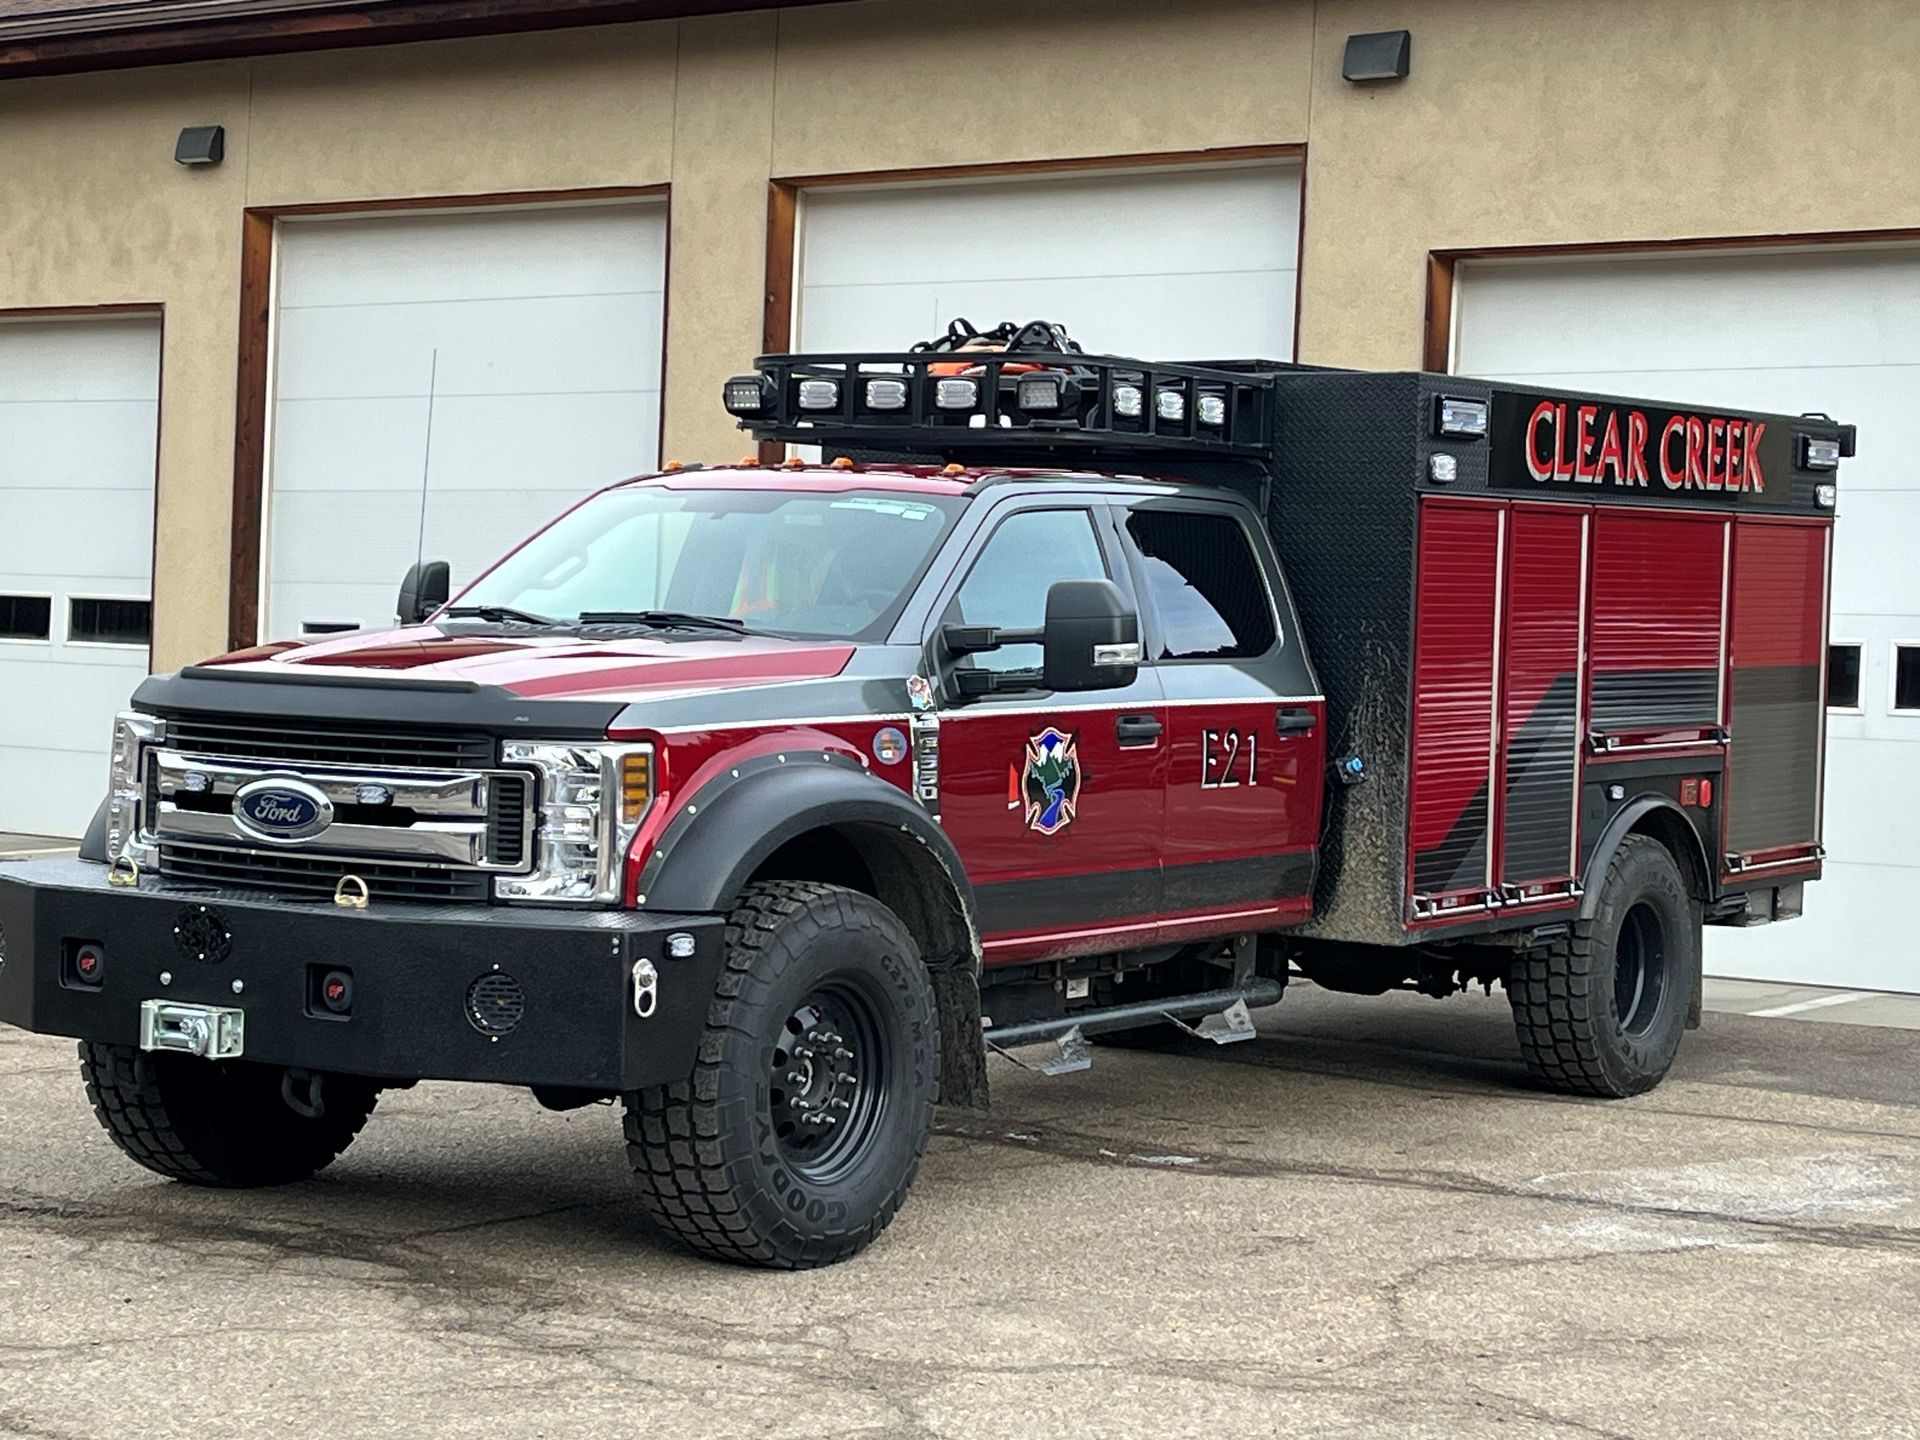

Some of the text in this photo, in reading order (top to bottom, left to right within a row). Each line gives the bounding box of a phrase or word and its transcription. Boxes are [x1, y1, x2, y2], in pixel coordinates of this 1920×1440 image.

[1526, 401, 1766, 493] CLEAR CREEK
[1201, 729, 1259, 789] E21
[254, 794, 302, 823] Ford
[755, 1003, 848, 1225] GOODYEA
